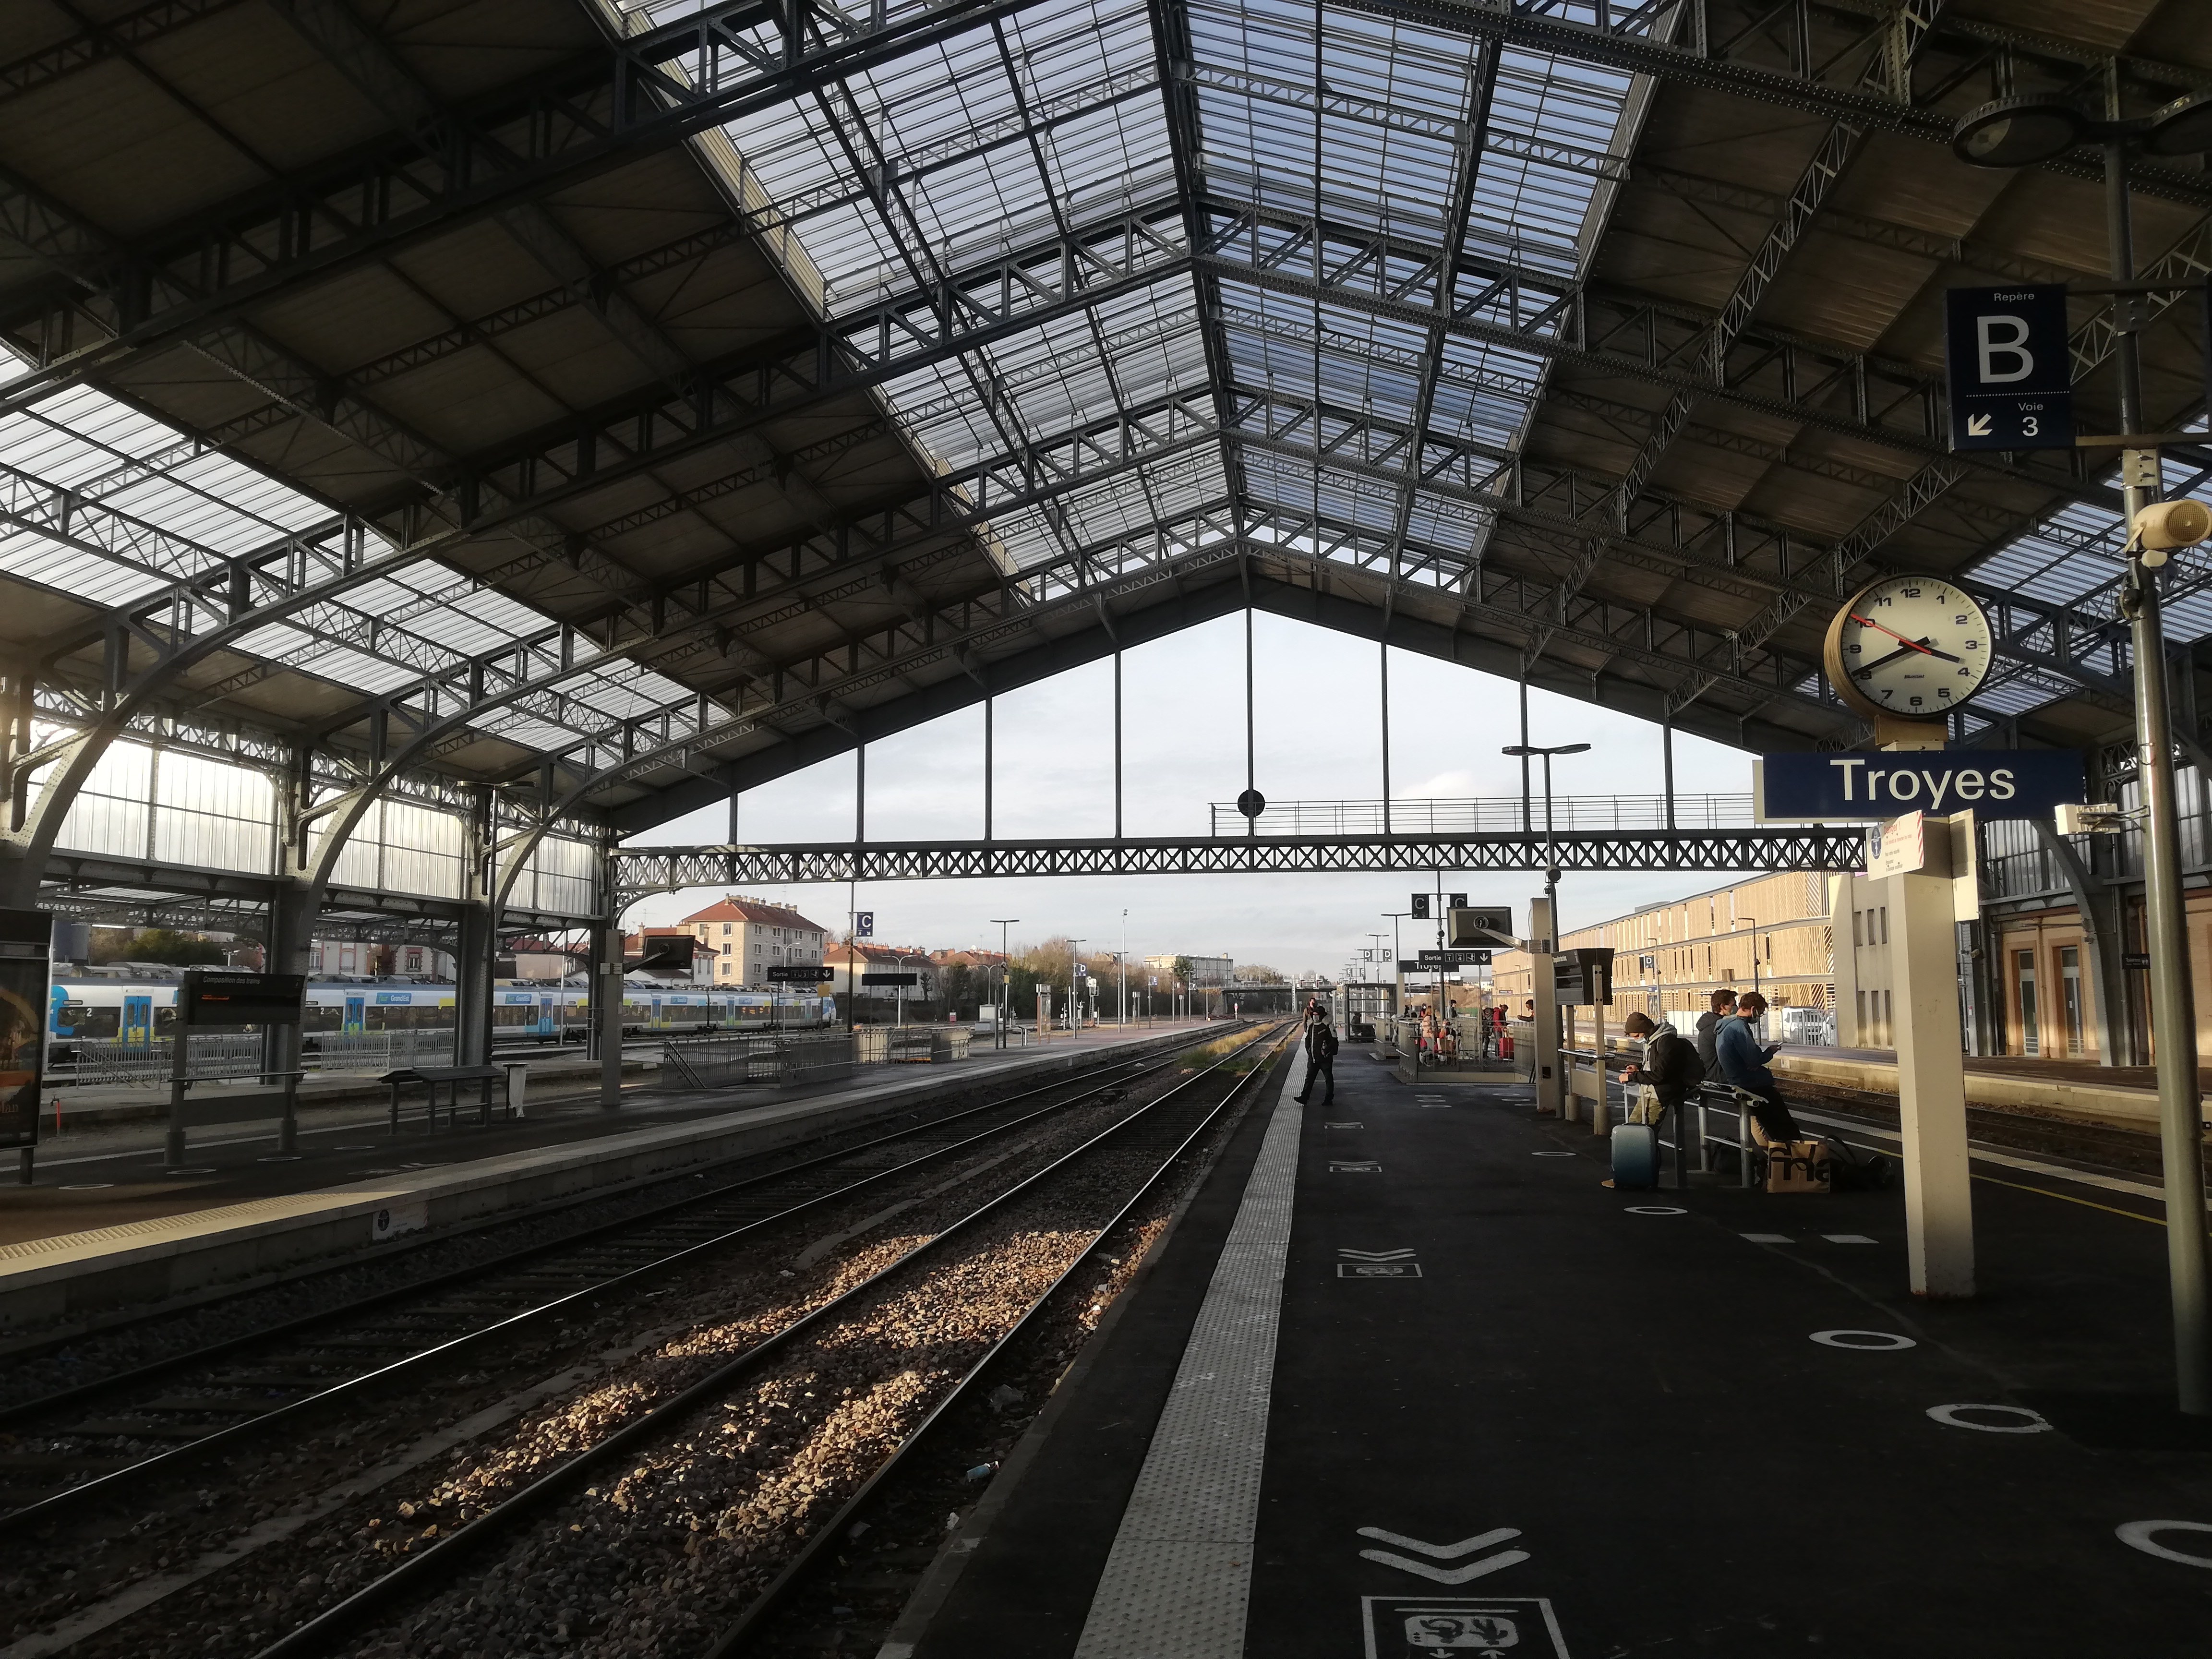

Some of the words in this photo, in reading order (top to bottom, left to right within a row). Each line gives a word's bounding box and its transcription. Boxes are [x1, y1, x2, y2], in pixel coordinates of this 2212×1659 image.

[1994, 291, 2035, 303] Repère
[1977, 315, 2034, 384] B
[2018, 402, 2044, 411] Voie
[2022, 416, 2039, 436] 3
[1900, 588, 1921, 598] 12
[1874, 597, 1892, 607] 11
[1936, 595, 1945, 604] 1
[1855, 618, 1875, 628] 10
[1955, 615, 1968, 625] 2
[1849, 644, 1862, 654] 9
[1965, 640, 1978, 649] 3
[1860, 671, 1872, 680] 8
[1957, 667, 1971, 677] 4
[1881, 690, 1893, 699] 7
[1937, 688, 1950, 697] 5
[1910, 697, 1923, 706] 6
[1829, 758, 2016, 810] Troyes
[1414, 897, 1425, 910] C
[1455, 897, 1465, 907] C
[862, 915, 872, 927] C
[203, 975, 236, 984] Composition
[86, 1008, 92, 1017] 2
